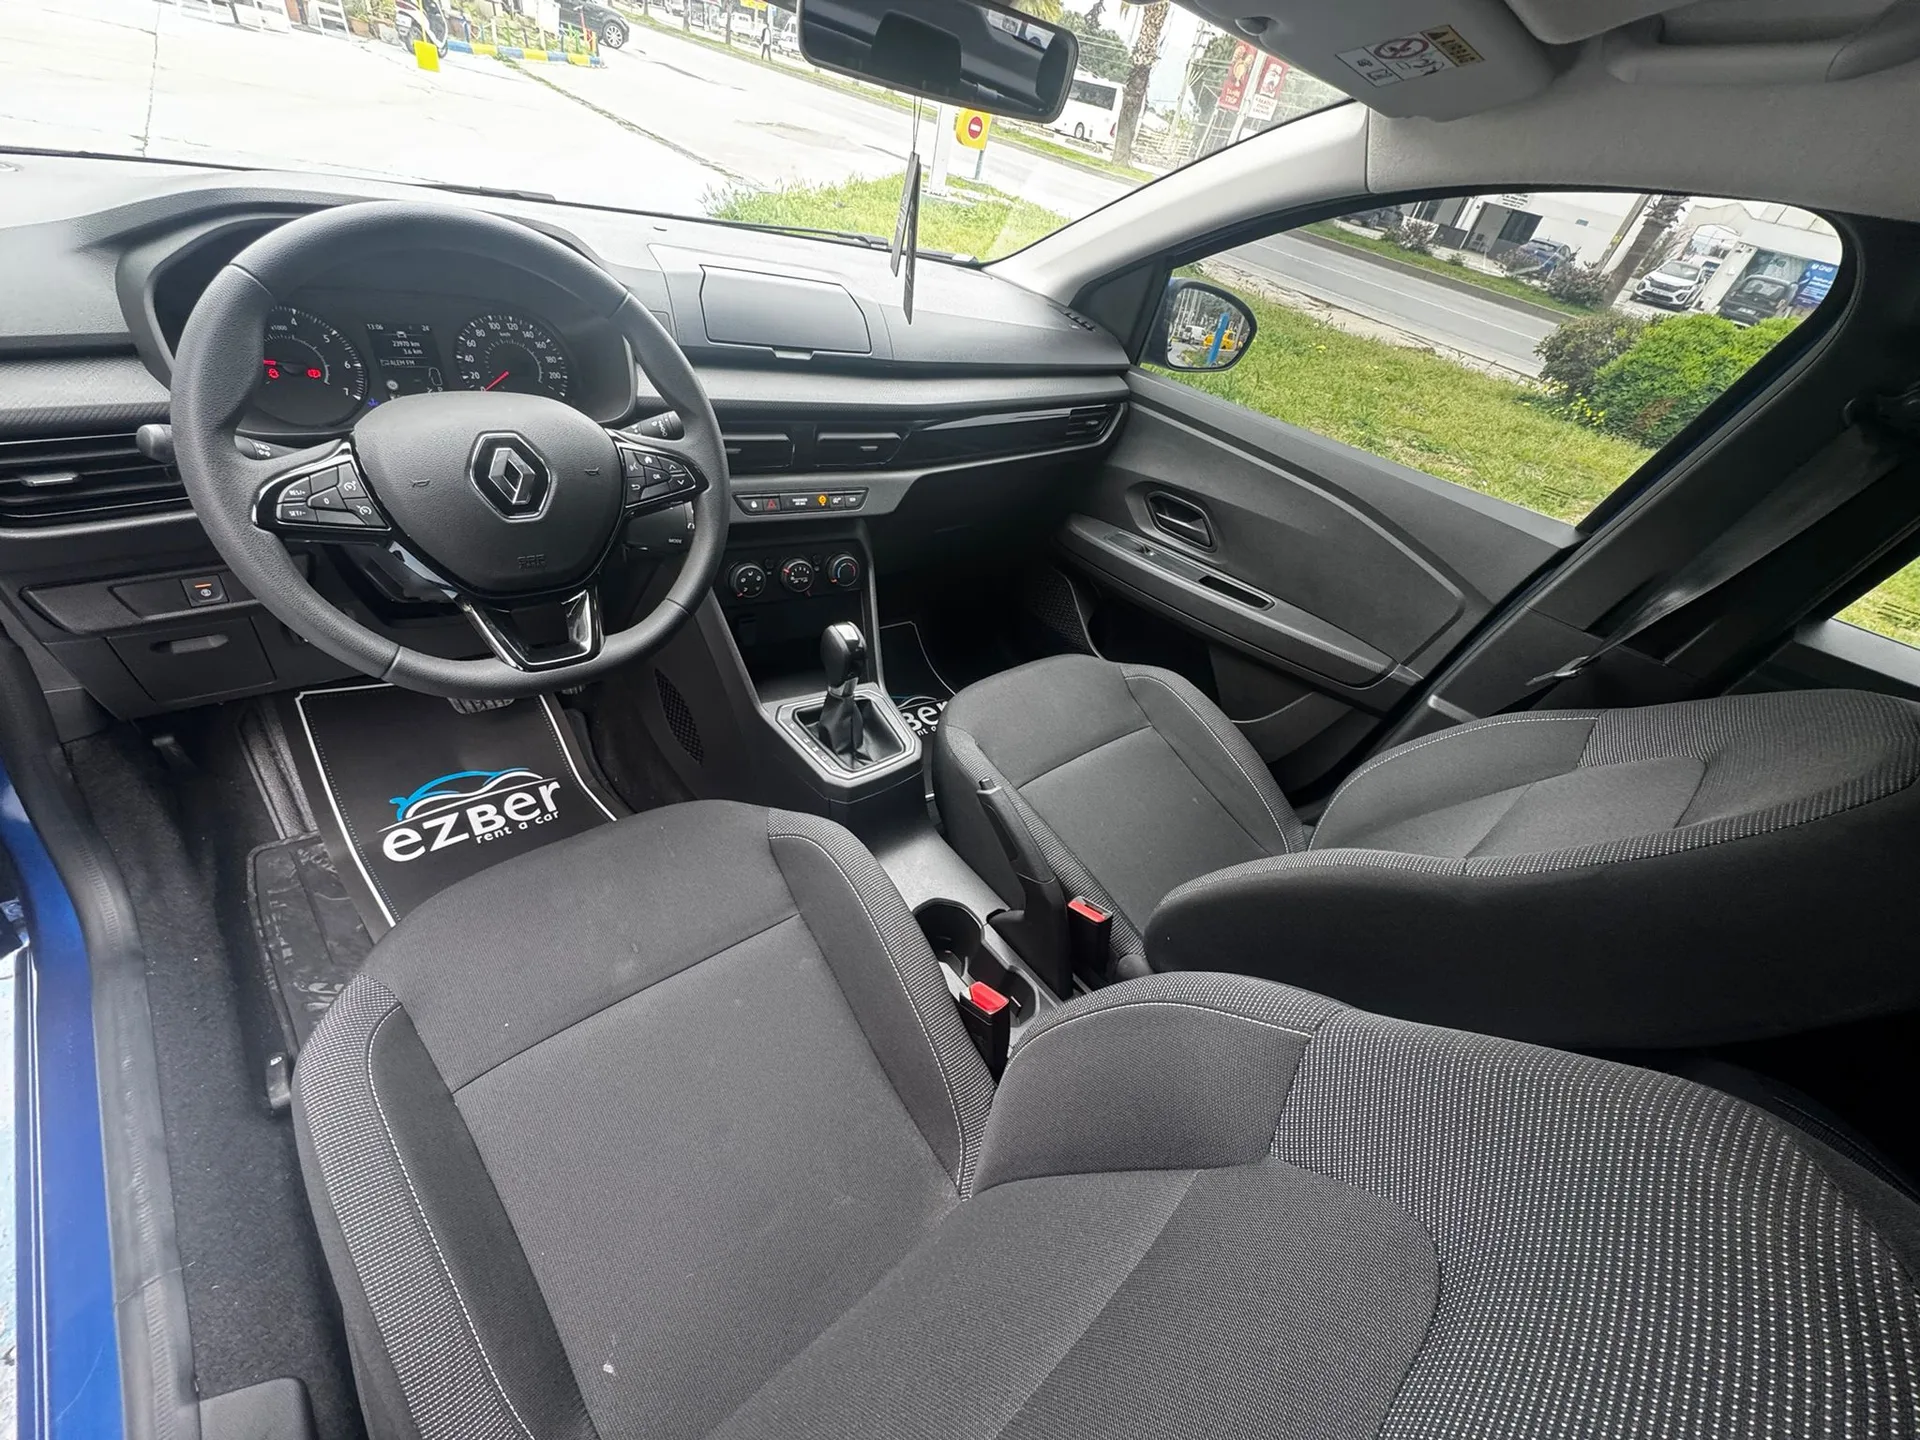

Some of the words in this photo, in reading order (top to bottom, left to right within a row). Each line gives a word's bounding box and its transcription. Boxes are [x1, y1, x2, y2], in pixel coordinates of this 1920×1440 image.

[488, 321, 501, 330] 100
[506, 322, 519, 331] 120
[475, 329, 486, 337] 80
[522, 330, 534, 339] 140
[323, 334, 330, 343] 5
[466, 339, 477, 348] 60
[535, 341, 547, 349] 160
[464, 354, 475, 363] 40
[545, 355, 557, 364] 180
[344, 360, 351, 369] 6
[469, 371, 480, 380] 20
[548, 371, 561, 380] 200
[342, 387, 349, 396] 7
[476, 826, 512, 844] rent
[518, 821, 528, 830] a
[535, 811, 559, 824] car
